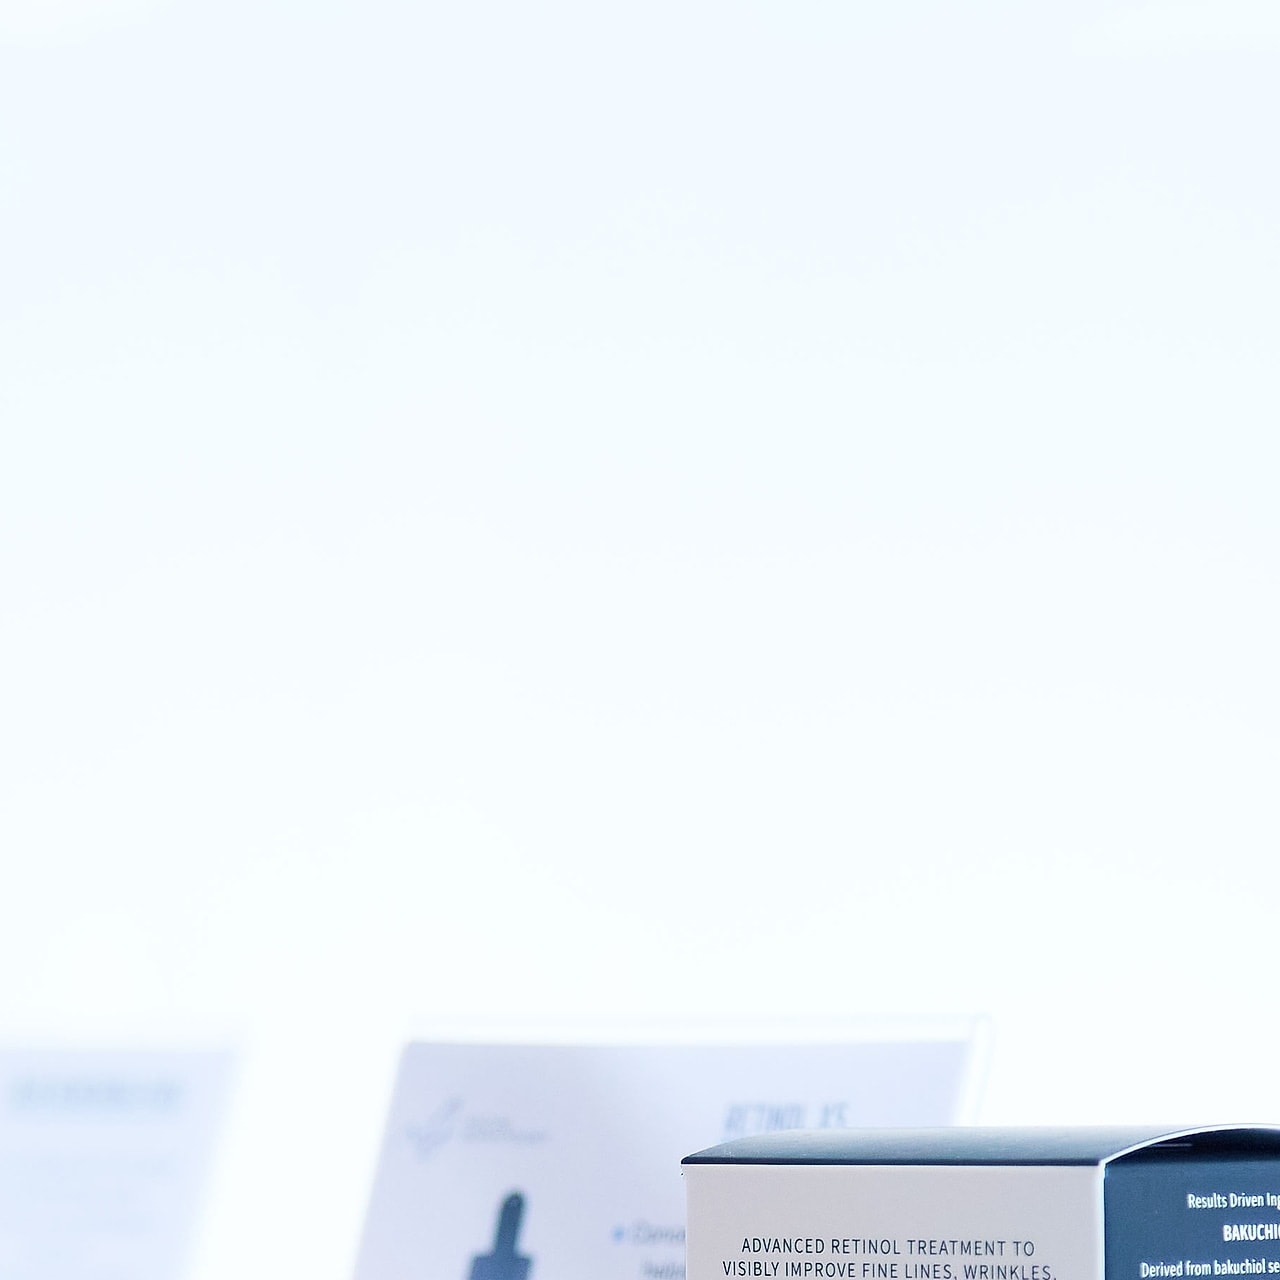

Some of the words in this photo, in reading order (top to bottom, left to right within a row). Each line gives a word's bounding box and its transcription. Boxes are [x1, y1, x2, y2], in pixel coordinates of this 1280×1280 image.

[1187, 1193, 1227, 1208] Results
[1230, 1193, 1264, 1208] Driven
[741, 1238, 825, 1254] ADVANCED
[831, 1239, 901, 1255] RETINOL
[907, 1239, 1006, 1256] TREATMENT
[1013, 1241, 1035, 1257] TO
[723, 1261, 780, 1277] VISIBLY
[785, 1262, 856, 1278] IMPROVE
[862, 1263, 899, 1279] FINE
[1141, 1261, 1183, 1278] Derived
[1186, 1260, 1211, 1276] from
[1214, 1259, 1266, 1275] bakuchiol
